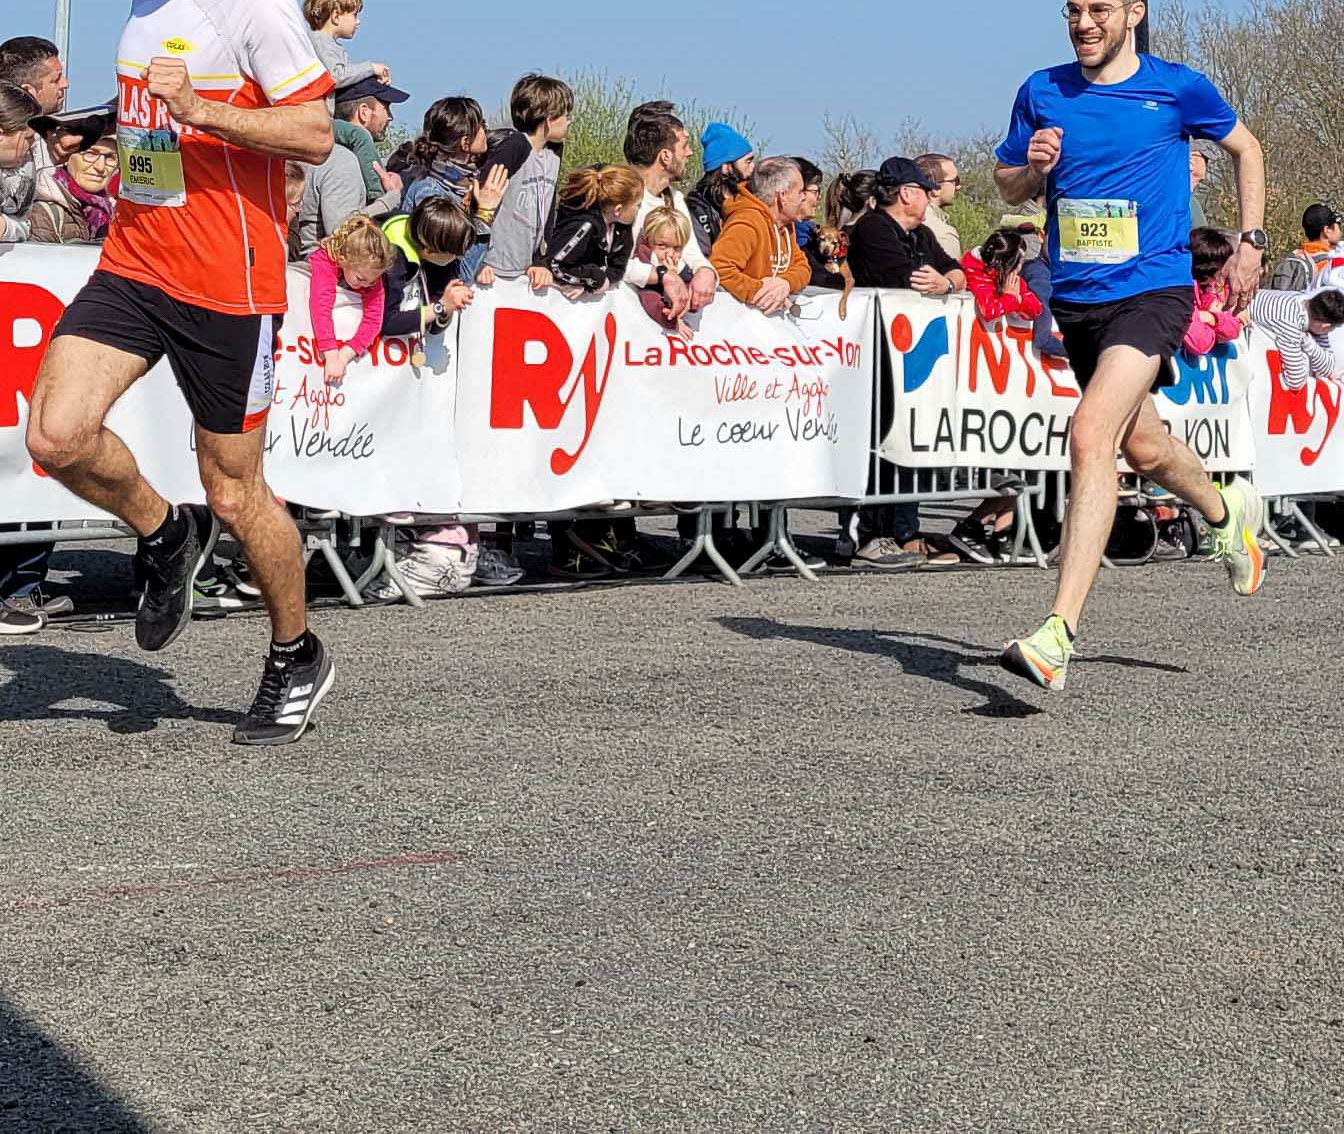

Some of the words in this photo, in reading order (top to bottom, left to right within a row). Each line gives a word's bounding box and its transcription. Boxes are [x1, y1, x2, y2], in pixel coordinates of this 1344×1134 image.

[129, 155, 153, 174] 995
[1080, 222, 1108, 238] 923
[624, 341, 663, 367] La
[667, 335, 861, 369] Roche-sur-Yon
[489, 307, 617, 476] Ry
[714, 372, 759, 404] Ville
[764, 377, 783, 399] et
[290, 414, 376, 459] Vendée
[677, 416, 705, 446] Le
